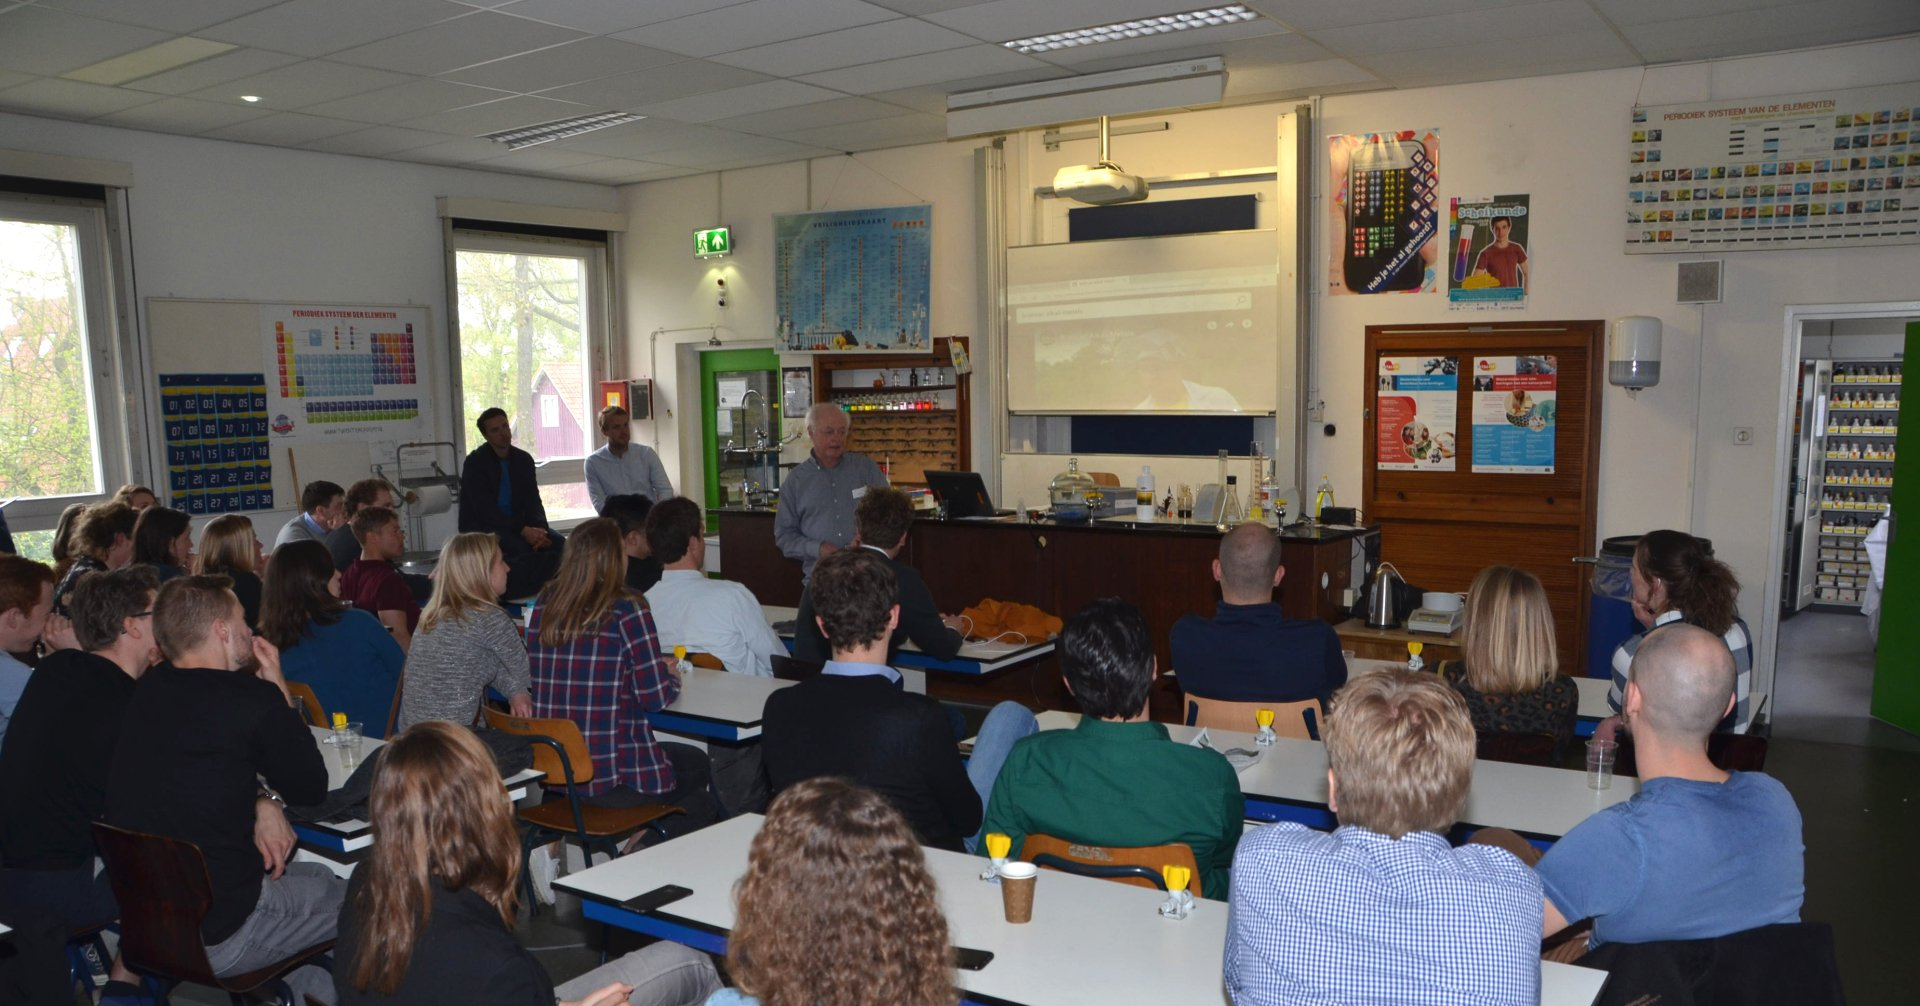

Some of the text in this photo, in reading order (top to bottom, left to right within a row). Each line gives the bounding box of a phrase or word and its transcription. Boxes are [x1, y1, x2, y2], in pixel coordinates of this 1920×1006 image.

[1663, 112, 1706, 121] PERIODIEK
[1708, 108, 1746, 118] SYSTEEM
[1748, 105, 1766, 114] VAN
[1768, 104, 1780, 113] DE
[1783, 99, 1836, 112] ELEMENTEN
[1459, 206, 1526, 218] Scheikunde
[813, 218, 887, 228] VEILIGHEIDSKAART
[1367, 221, 1433, 291] Heb je het al gehoord?
[292, 310, 397, 319] PERIODIEK SYSTEEM DER ELEMENTEN
[169, 398, 264, 410] 01 02 03 04 05 06
[171, 426, 181, 437] 07
[188, 425, 198, 436] 08
[205, 424, 215, 434] 09
[225, 424, 234, 434] 10
[241, 423, 249, 433] 11
[256, 422, 265, 432] 12
[175, 446, 267, 461] 13 14 15 16 17 18
[193, 474, 203, 485] 20
[210, 474, 220, 483] 21
[228, 472, 237, 482] 22
[244, 471, 254, 481] 23
[260, 471, 269, 480] 24
[193, 499, 203, 509] 26
[210, 498, 221, 508] 27
[229, 497, 239, 507] 28
[246, 495, 256, 505] 29
[261, 495, 271, 504] 30
